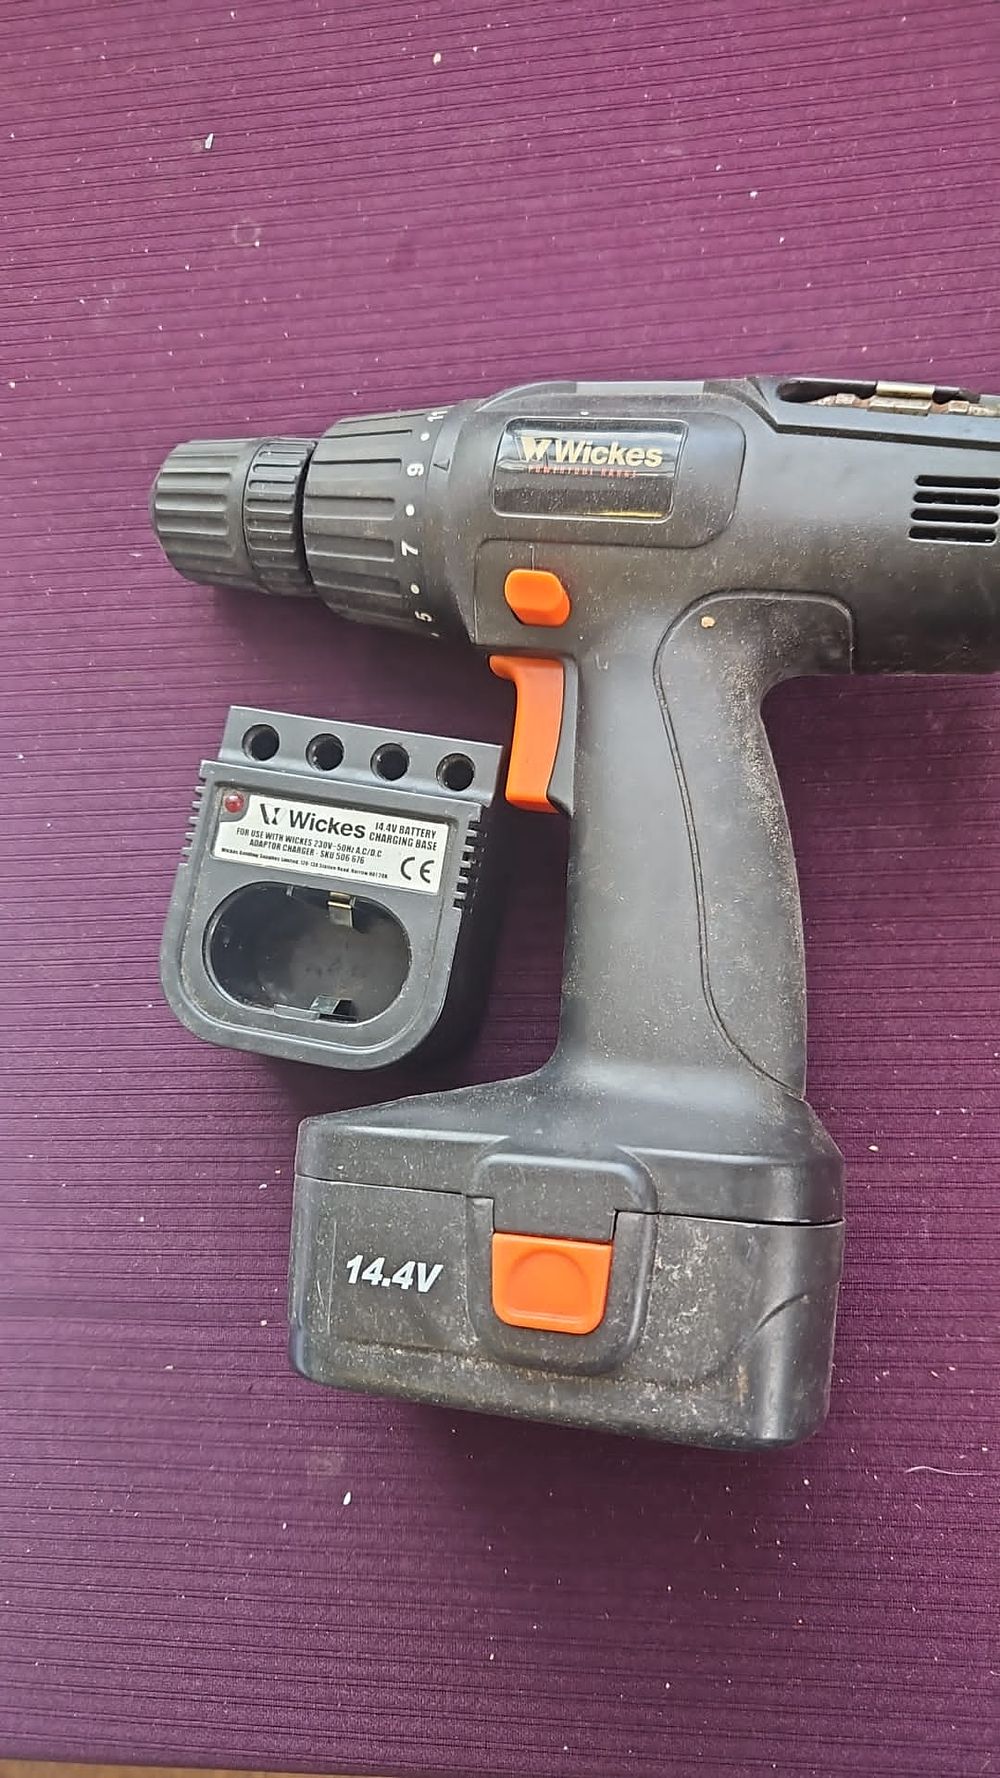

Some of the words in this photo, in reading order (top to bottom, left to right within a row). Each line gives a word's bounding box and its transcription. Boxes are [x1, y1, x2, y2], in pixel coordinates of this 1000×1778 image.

[554, 438, 663, 468] Wickes
[401, 540, 419, 556] 7
[289, 809, 366, 839] Wickes
[375, 821, 398, 833] 14.4V
[399, 824, 437, 839] BATTERY
[236, 827, 250, 836] FOR
[251, 829, 264, 839] USE
[265, 832, 284, 841] WITH
[285, 834, 313, 847] WICKES
[369, 832, 414, 847] CHARGING
[415, 839, 437, 851] BASE
[249, 839, 281, 851] ADAPTOR
[282, 843, 315, 856] CHARGER
[320, 850, 335, 859] SKU
[346, 1254, 443, 1293] 14.4V
